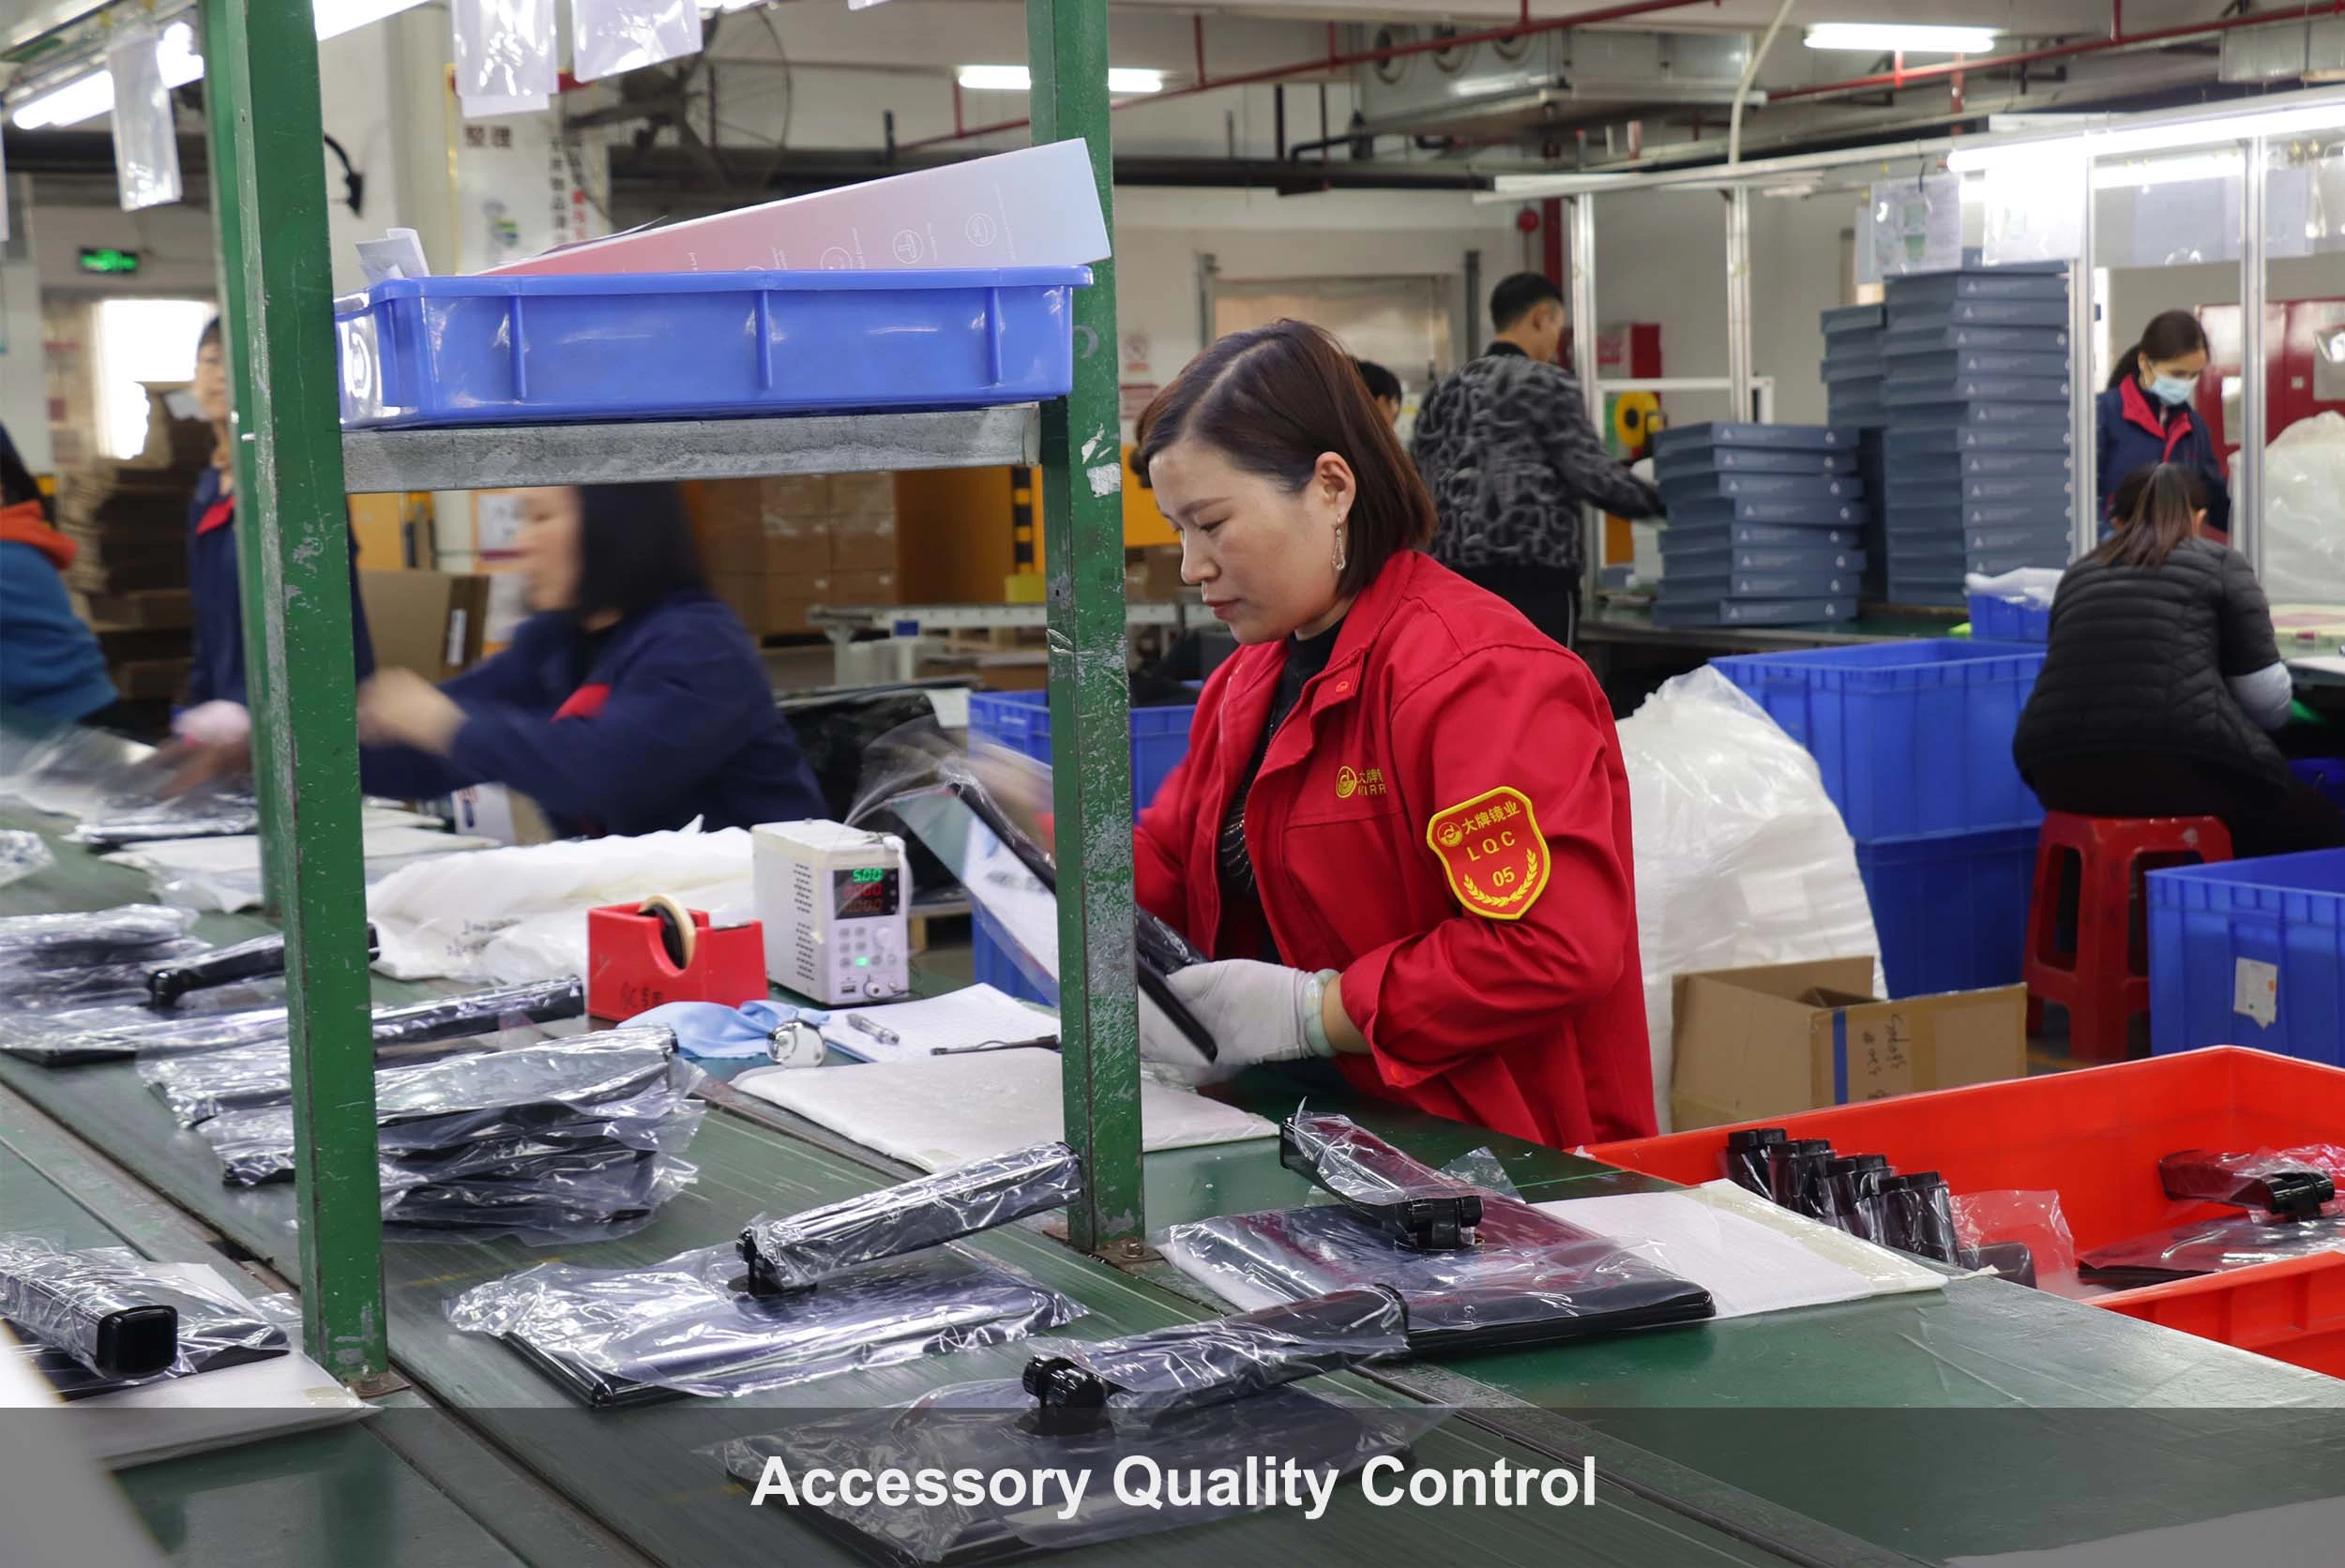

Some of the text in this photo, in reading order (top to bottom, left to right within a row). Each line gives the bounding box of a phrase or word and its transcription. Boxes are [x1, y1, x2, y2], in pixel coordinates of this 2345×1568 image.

[1462, 801, 1520, 835] 大牌镜业
[1492, 866, 1515, 886] 05
